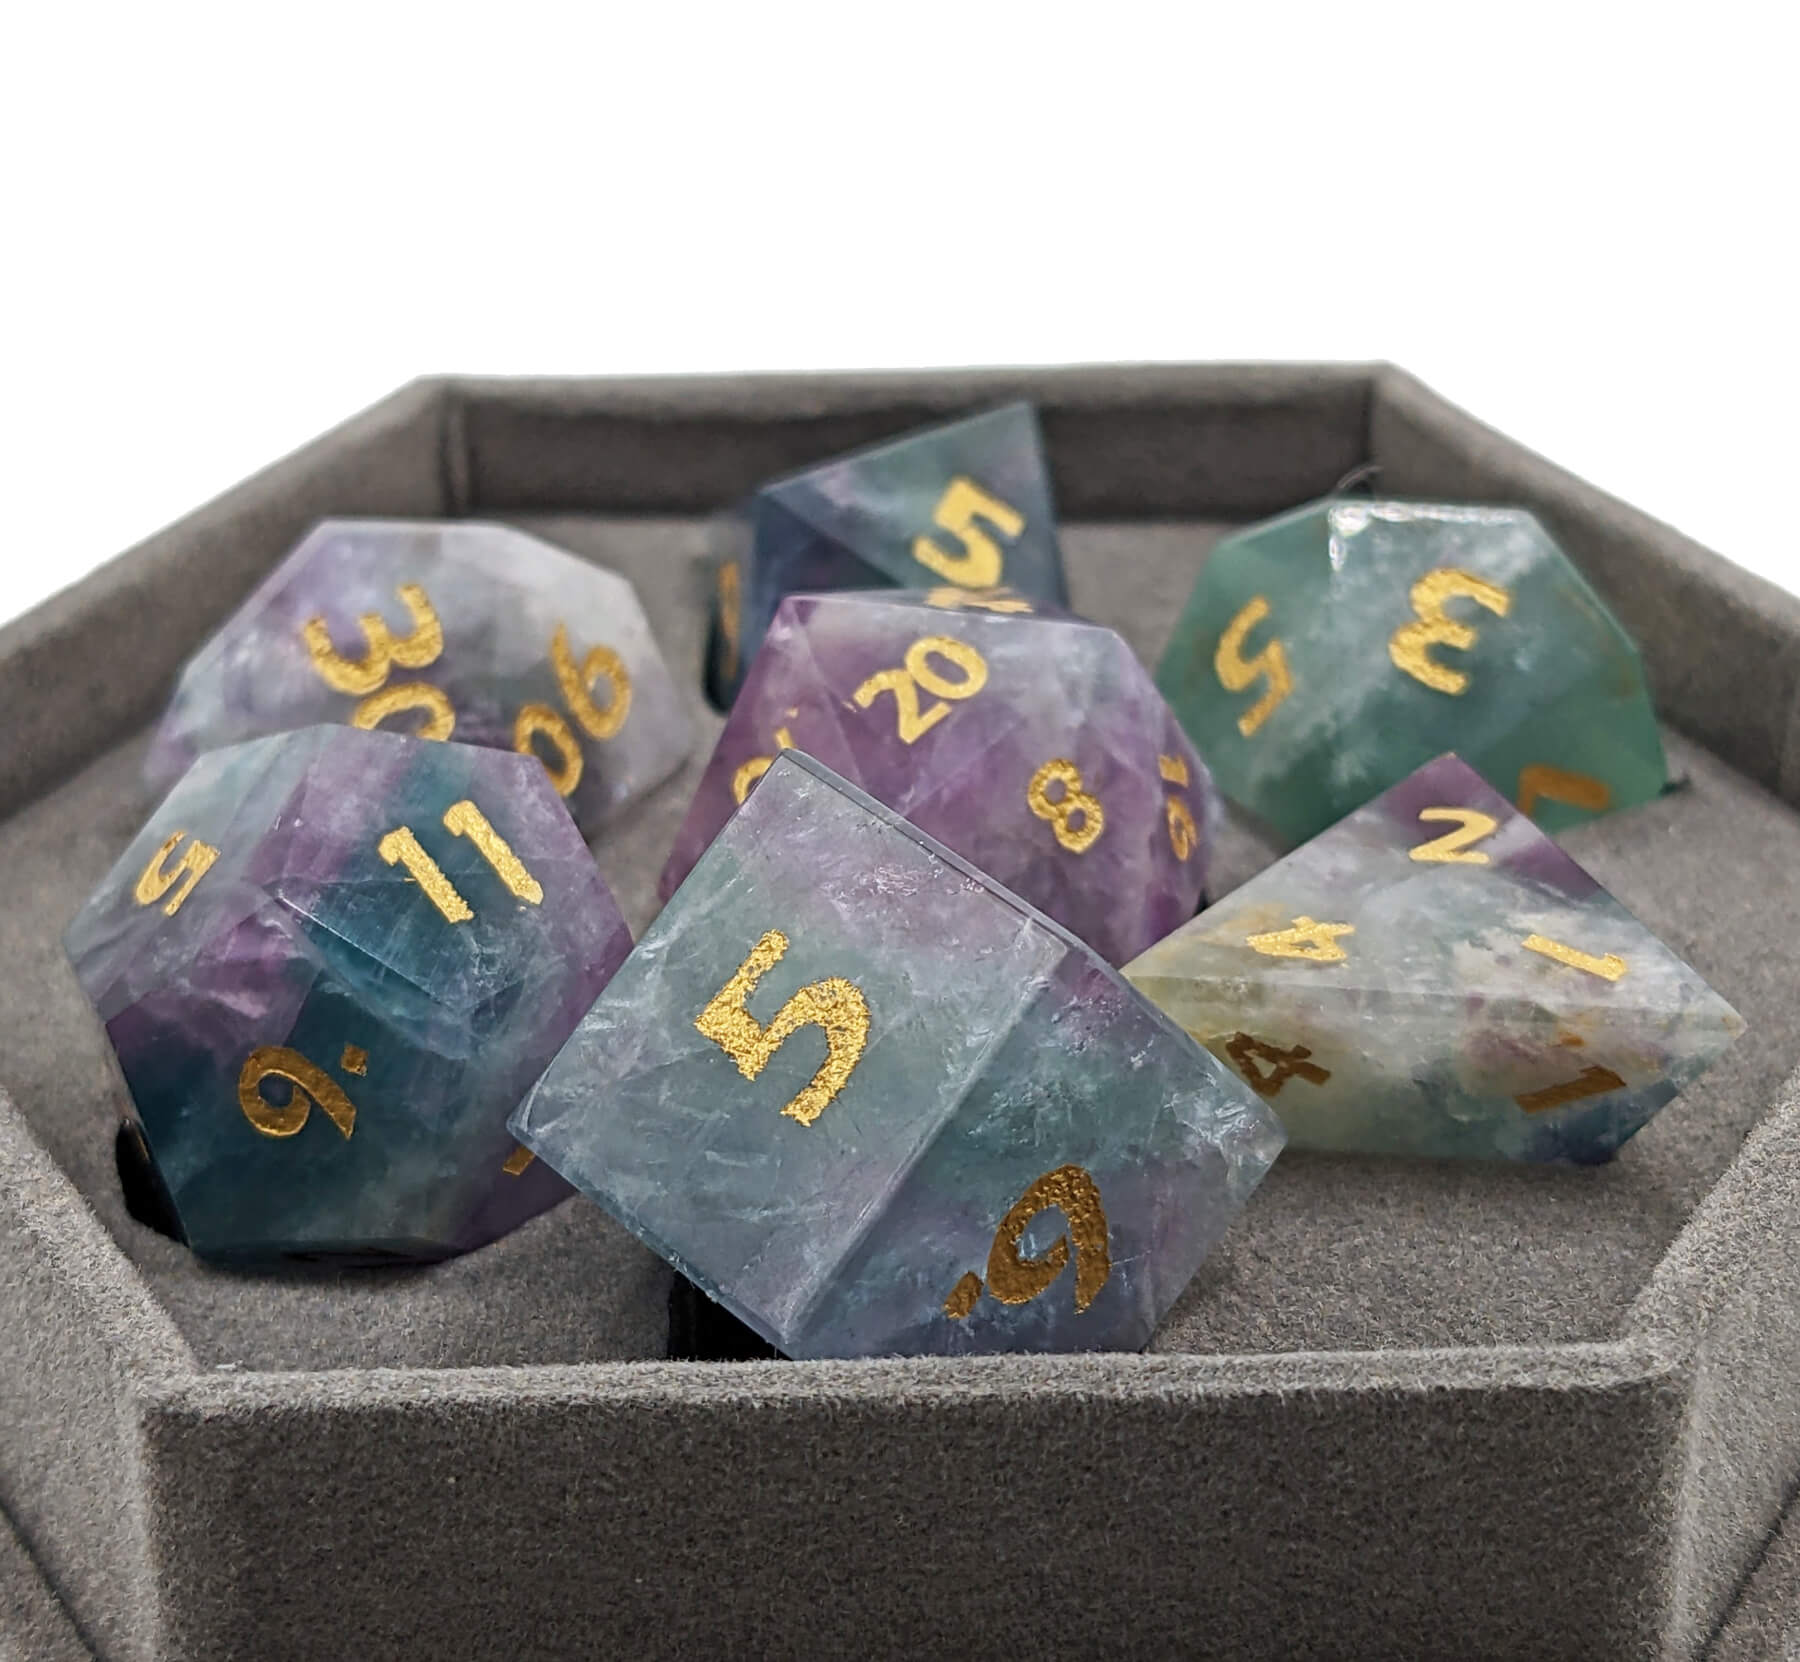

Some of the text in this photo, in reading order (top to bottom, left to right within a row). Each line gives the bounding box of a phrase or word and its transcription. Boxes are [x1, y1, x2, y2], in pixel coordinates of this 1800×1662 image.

[911, 474, 1026, 588] 5
[1213, 596, 1294, 737] 5
[1388, 566, 1512, 694] 3
[853, 635, 988, 745] 20
[1027, 758, 1104, 854] 8
[1408, 806, 1497, 864] 2
[135, 829, 222, 917] 5
[378, 800, 544, 924] 11
[1246, 915, 1356, 964] 4
[1520, 933, 1628, 982] 1
[695, 928, 872, 1127] 5
[1226, 1031, 1332, 1098] 4
